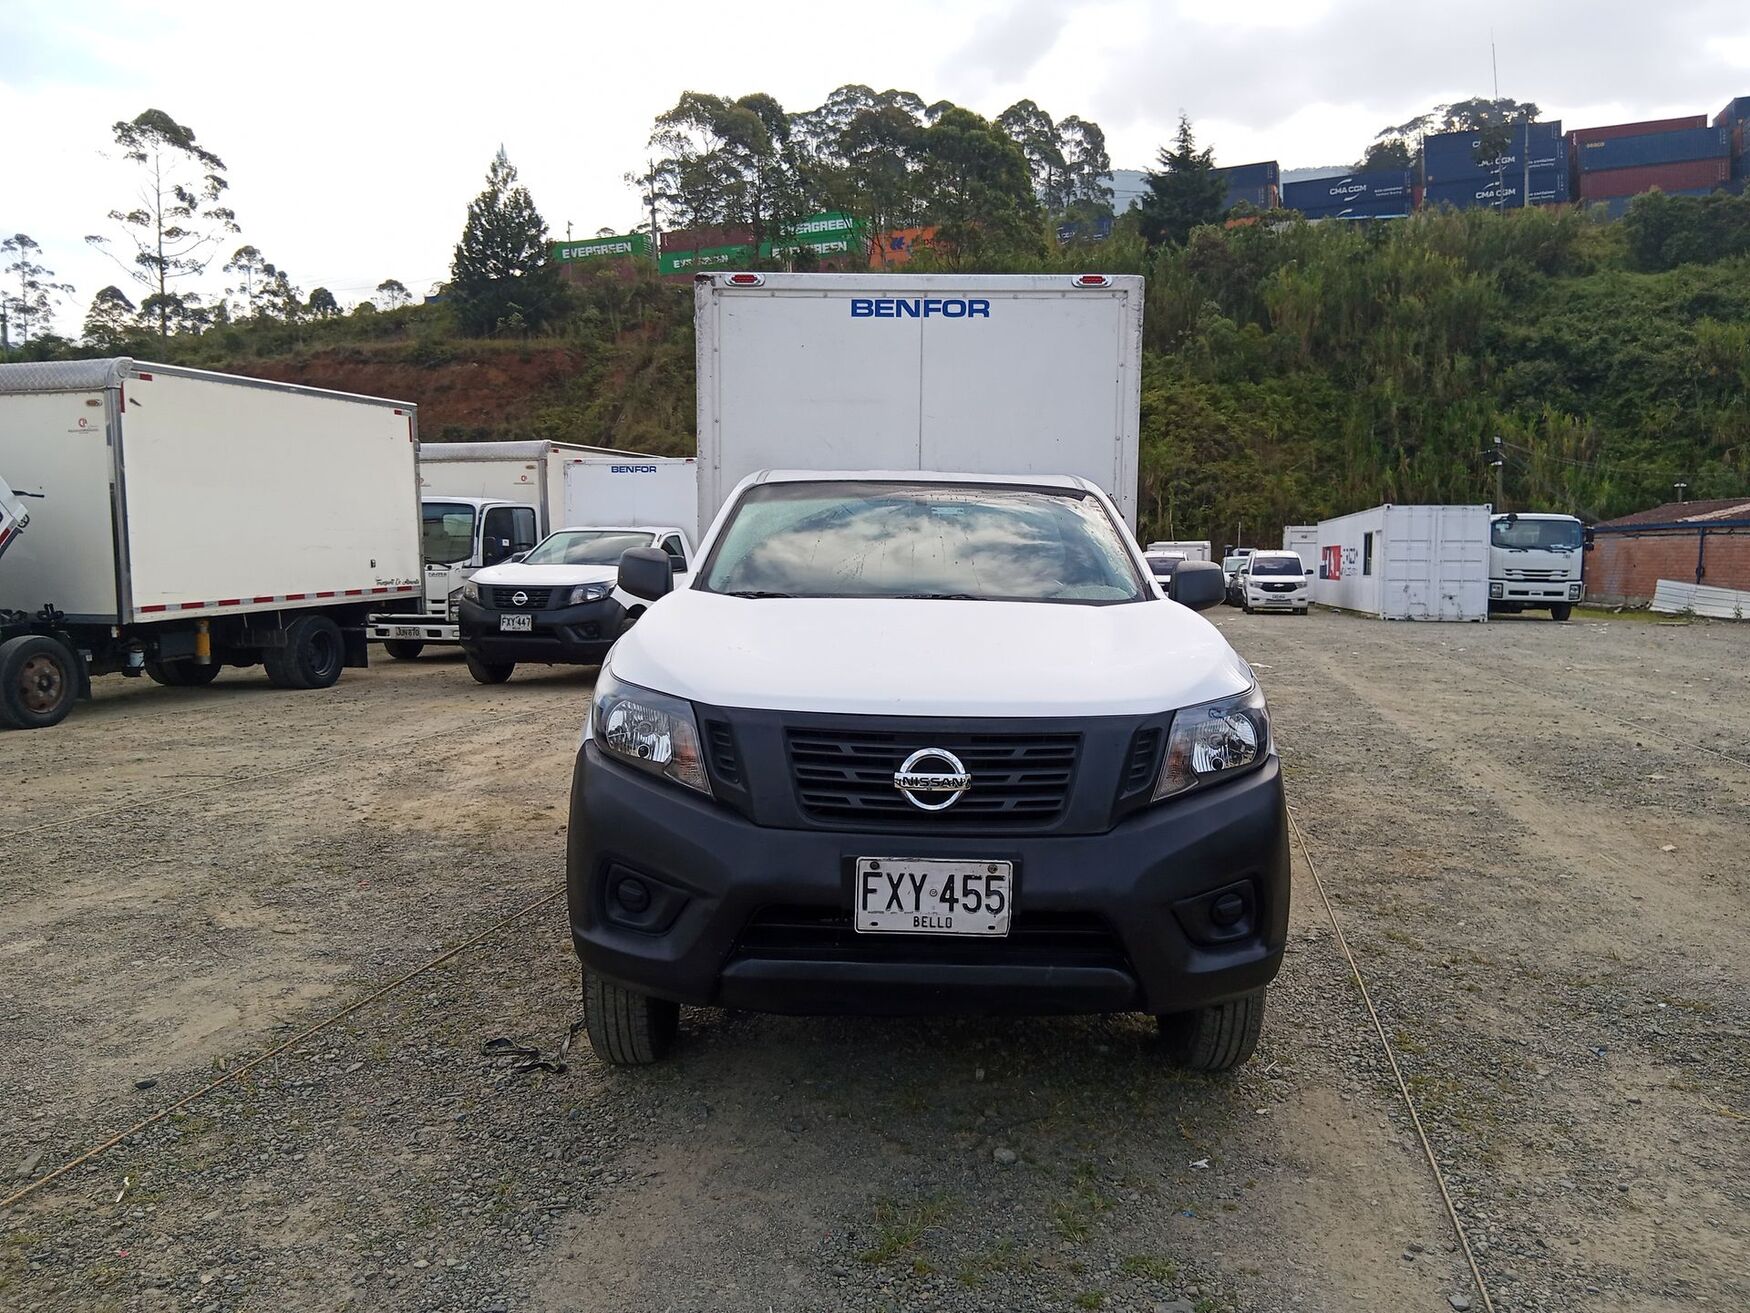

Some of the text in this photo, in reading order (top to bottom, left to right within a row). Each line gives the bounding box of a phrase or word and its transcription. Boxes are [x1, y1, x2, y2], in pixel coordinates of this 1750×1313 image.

[1348, 184, 1367, 193] CGM
[1475, 190, 1494, 199] CMA
[562, 242, 632, 259] EVERGREEN
[851, 299, 990, 318] BENFOR
[611, 465, 657, 473] BENFOR
[902, 776, 963, 788] NISSAN
[862, 871, 1006, 915] FXY 455
[913, 916, 953, 929] BELLO
